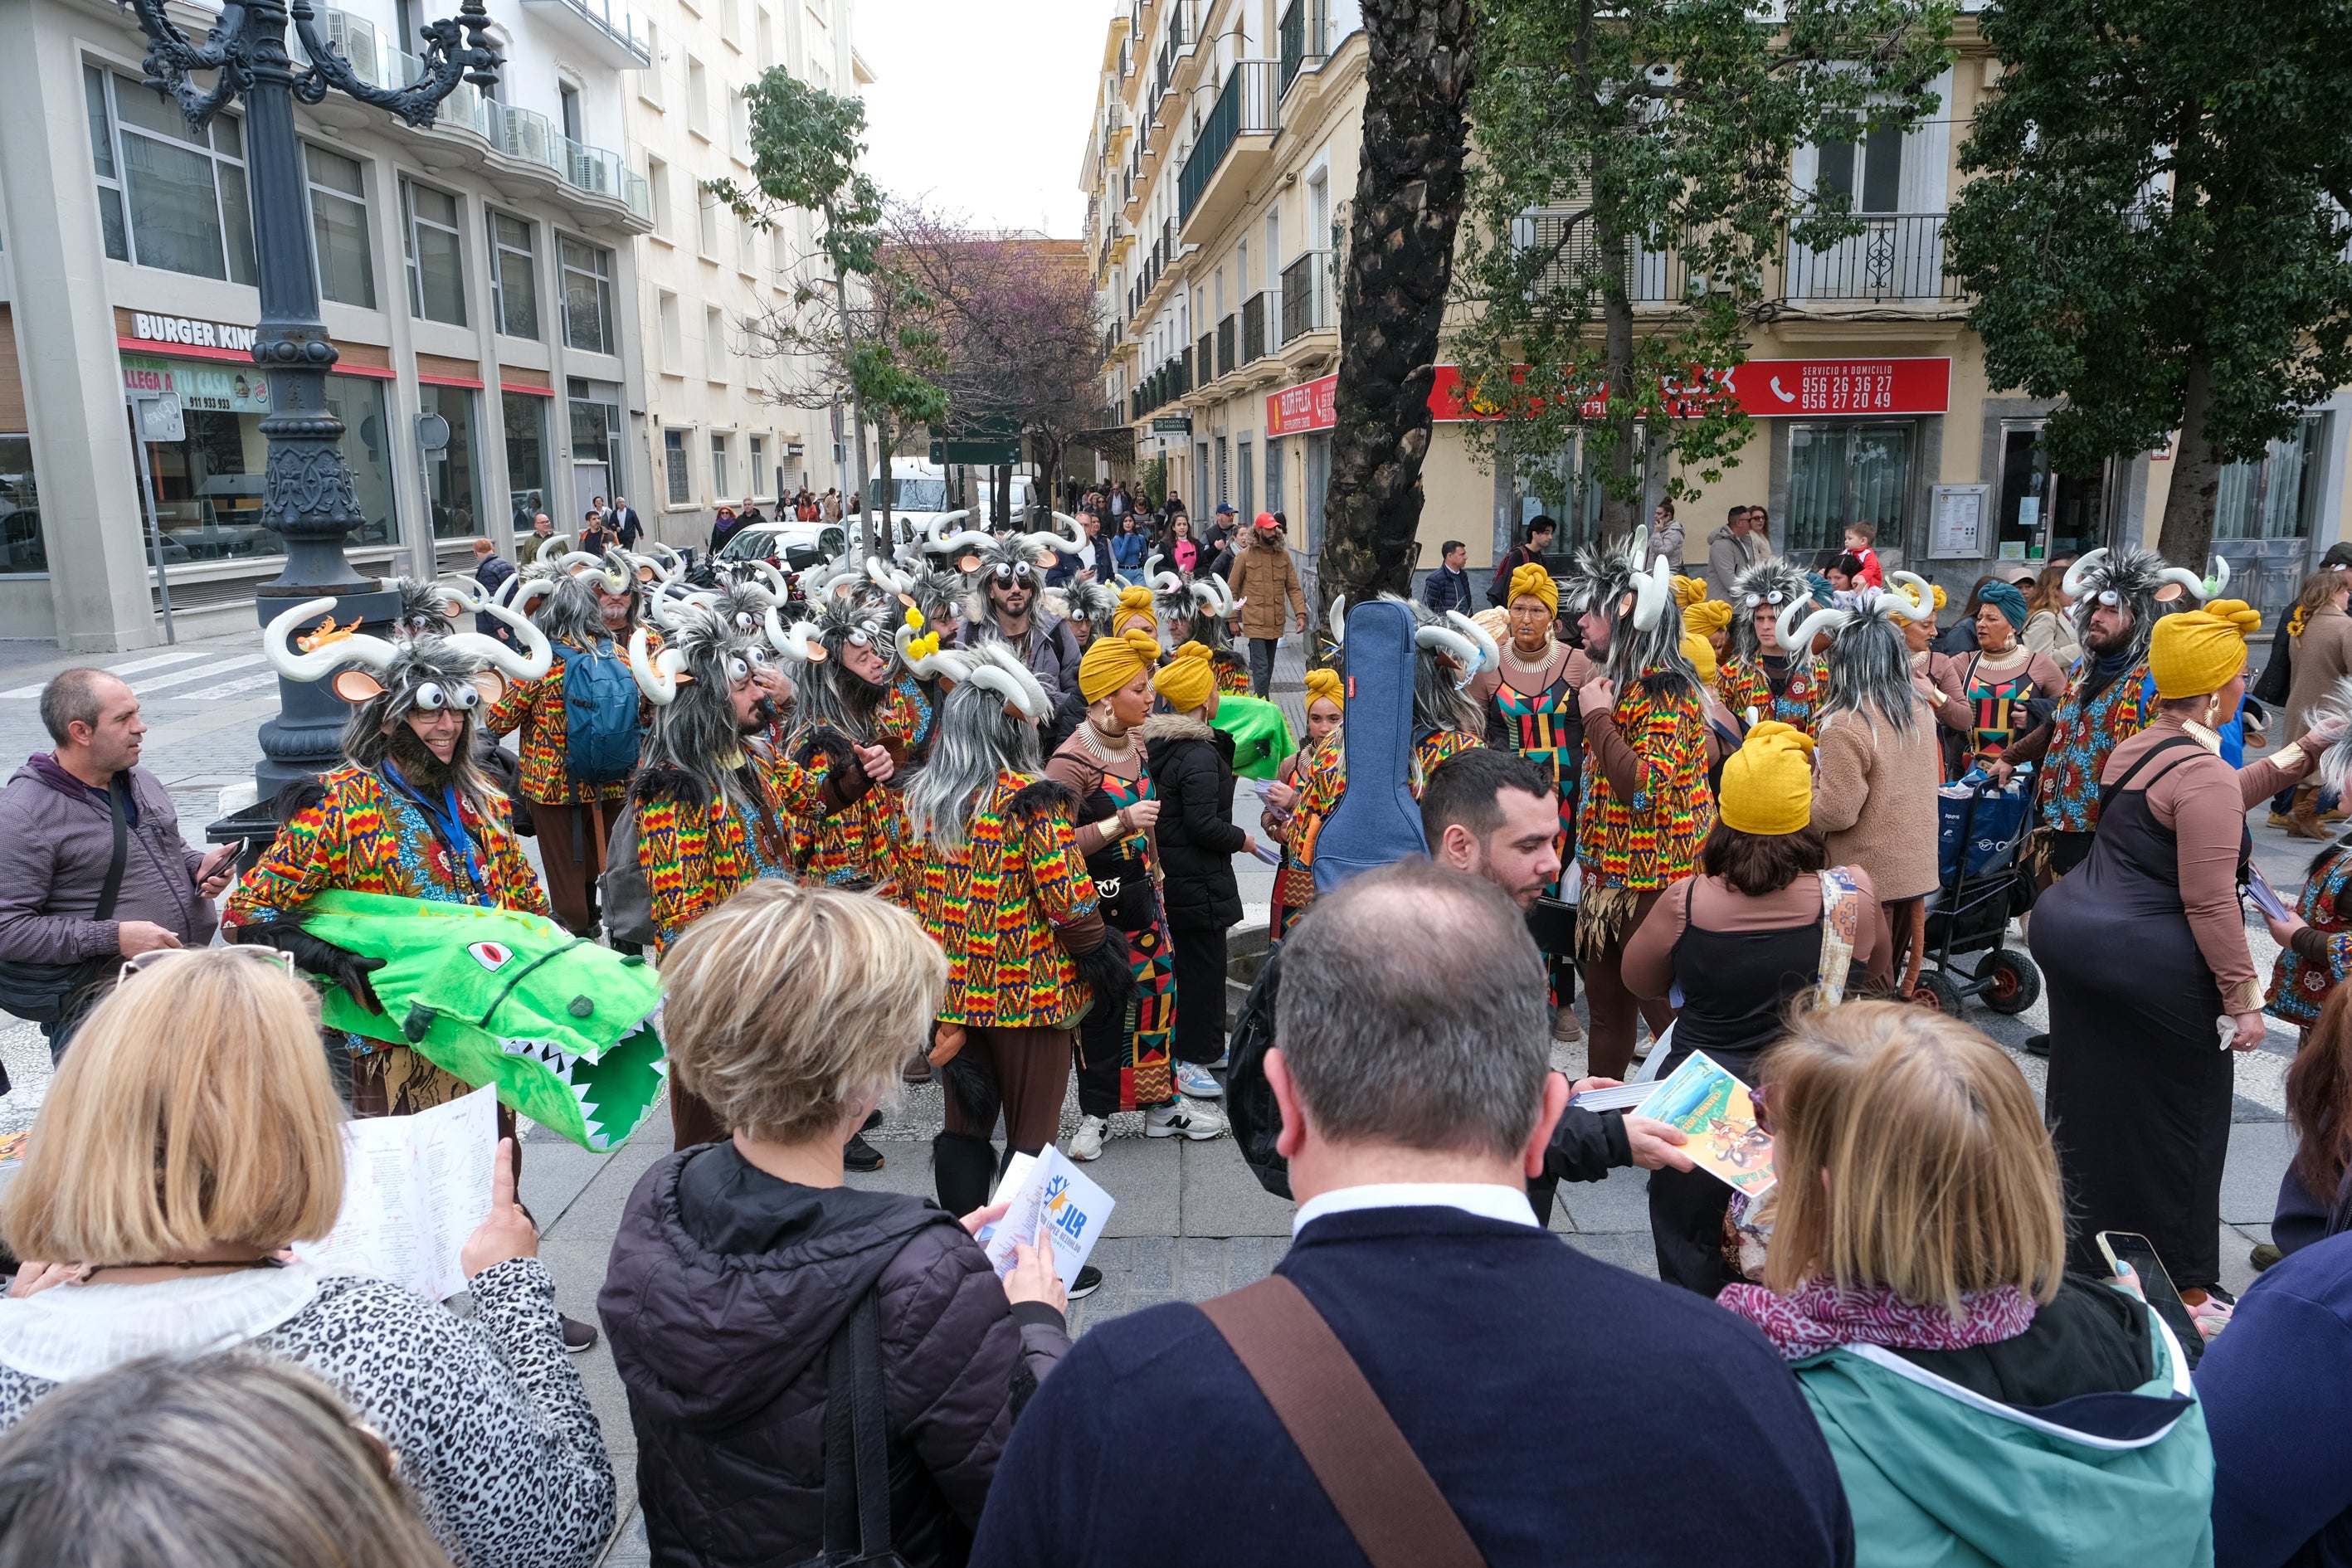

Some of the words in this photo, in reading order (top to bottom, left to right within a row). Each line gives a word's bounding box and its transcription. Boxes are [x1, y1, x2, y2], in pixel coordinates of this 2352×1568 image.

[134, 314, 217, 348] BURGER
[1802, 367, 1839, 376] SERVICIO
[1843, 366, 1848, 375] A
[1851, 365, 1892, 375] DOMICILIO
[124, 369, 162, 391] LLEGA
[165, 373, 173, 392] A
[173, 369, 193, 394] TU
[197, 372, 232, 396] CASA
[1802, 377, 1827, 392] 956
[1833, 377, 1848, 392] 26
[1854, 376, 1871, 392] 36
[1877, 376, 1892, 392] 27
[189, 396, 202, 407] 911
[203, 397, 216, 408] 933
[217, 398, 231, 410] 933
[1802, 393, 1826, 409] 956
[1833, 393, 1847, 409] 27
[1853, 392, 1868, 408] 20
[1874, 392, 1891, 408] 49
[1694, 1092, 1721, 1118] CARNAVAL
[1055, 1203, 1088, 1239] JLR
